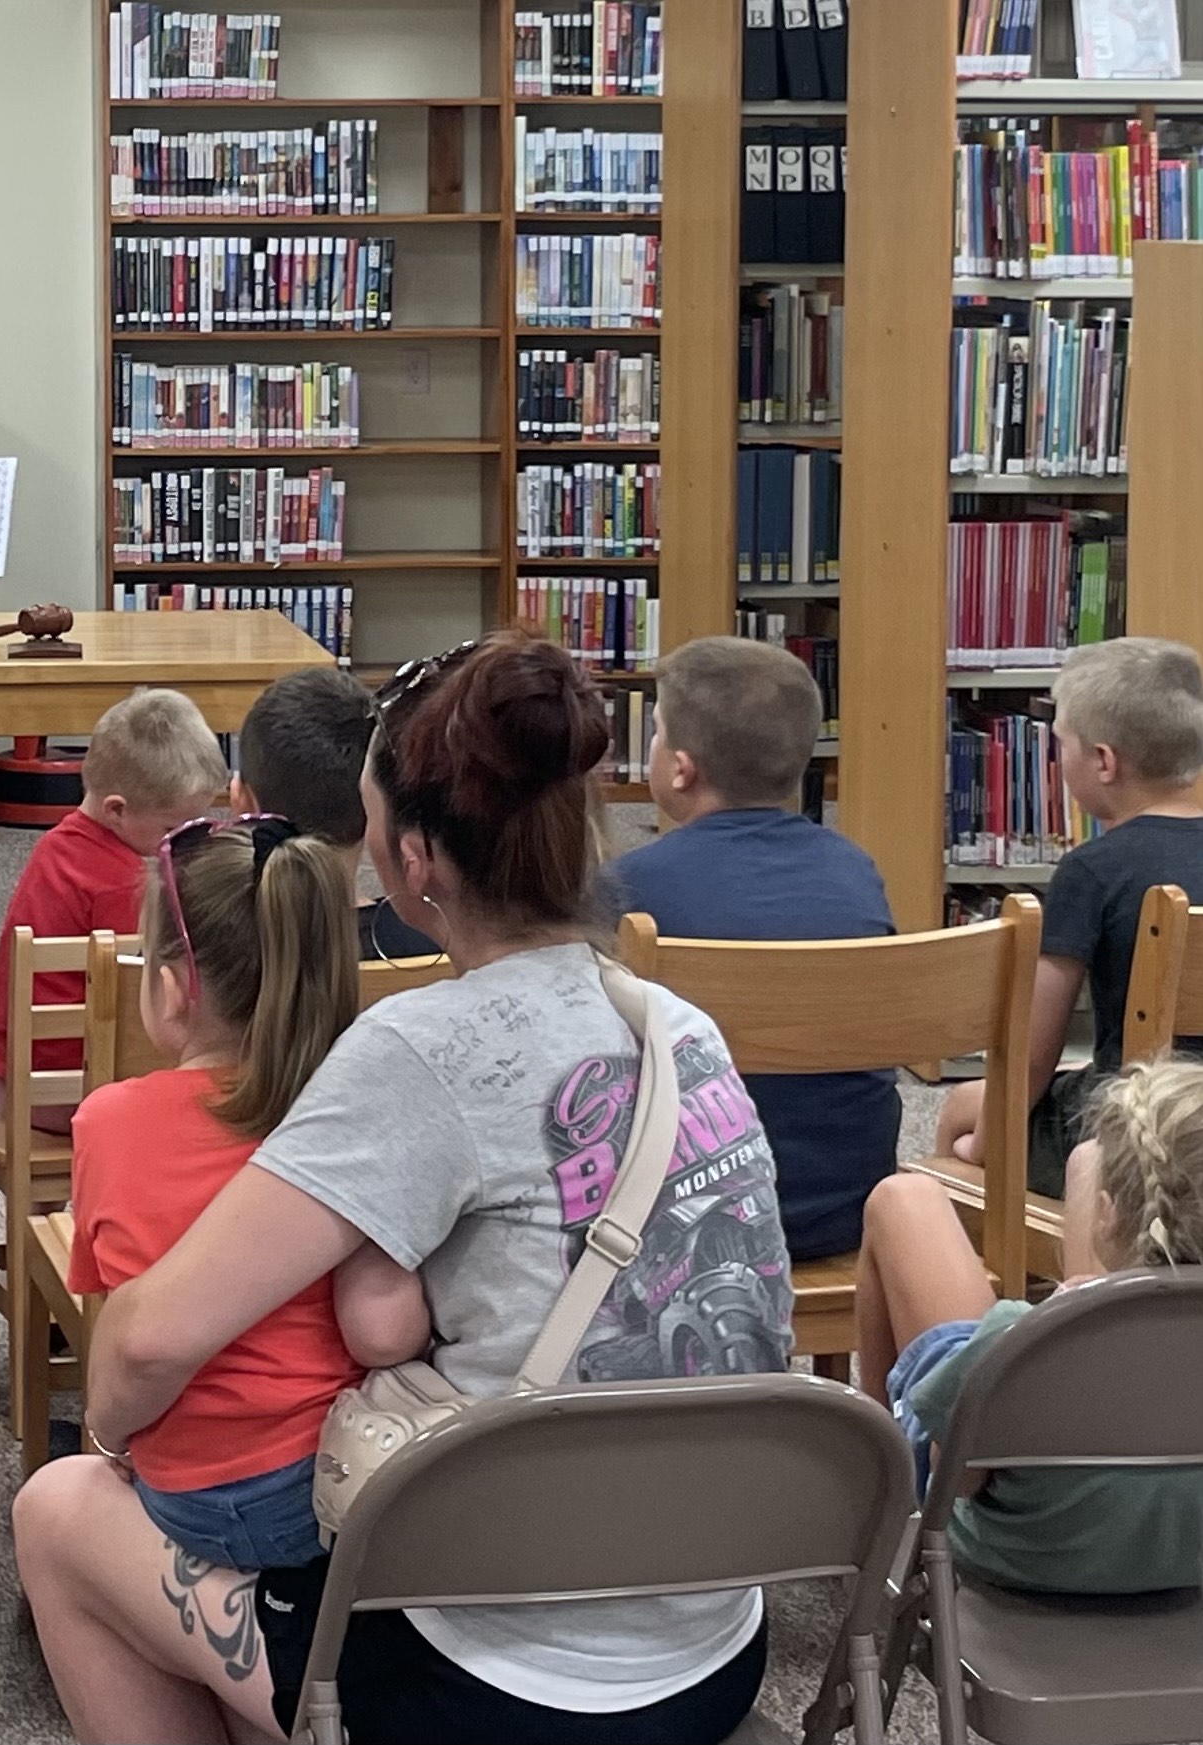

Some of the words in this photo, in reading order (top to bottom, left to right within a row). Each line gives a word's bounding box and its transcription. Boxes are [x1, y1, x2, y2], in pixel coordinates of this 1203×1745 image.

[749, 9, 766, 26] B
[786, 8, 808, 26] D
[821, 9, 838, 29] F
[749, 148, 768, 165] M
[779, 148, 801, 166] O
[811, 148, 831, 169] Q
[749, 173, 767, 190] N
[781, 173, 797, 191] P
[813, 174, 831, 191] R
[674, 1144, 755, 1200] MONSTER
